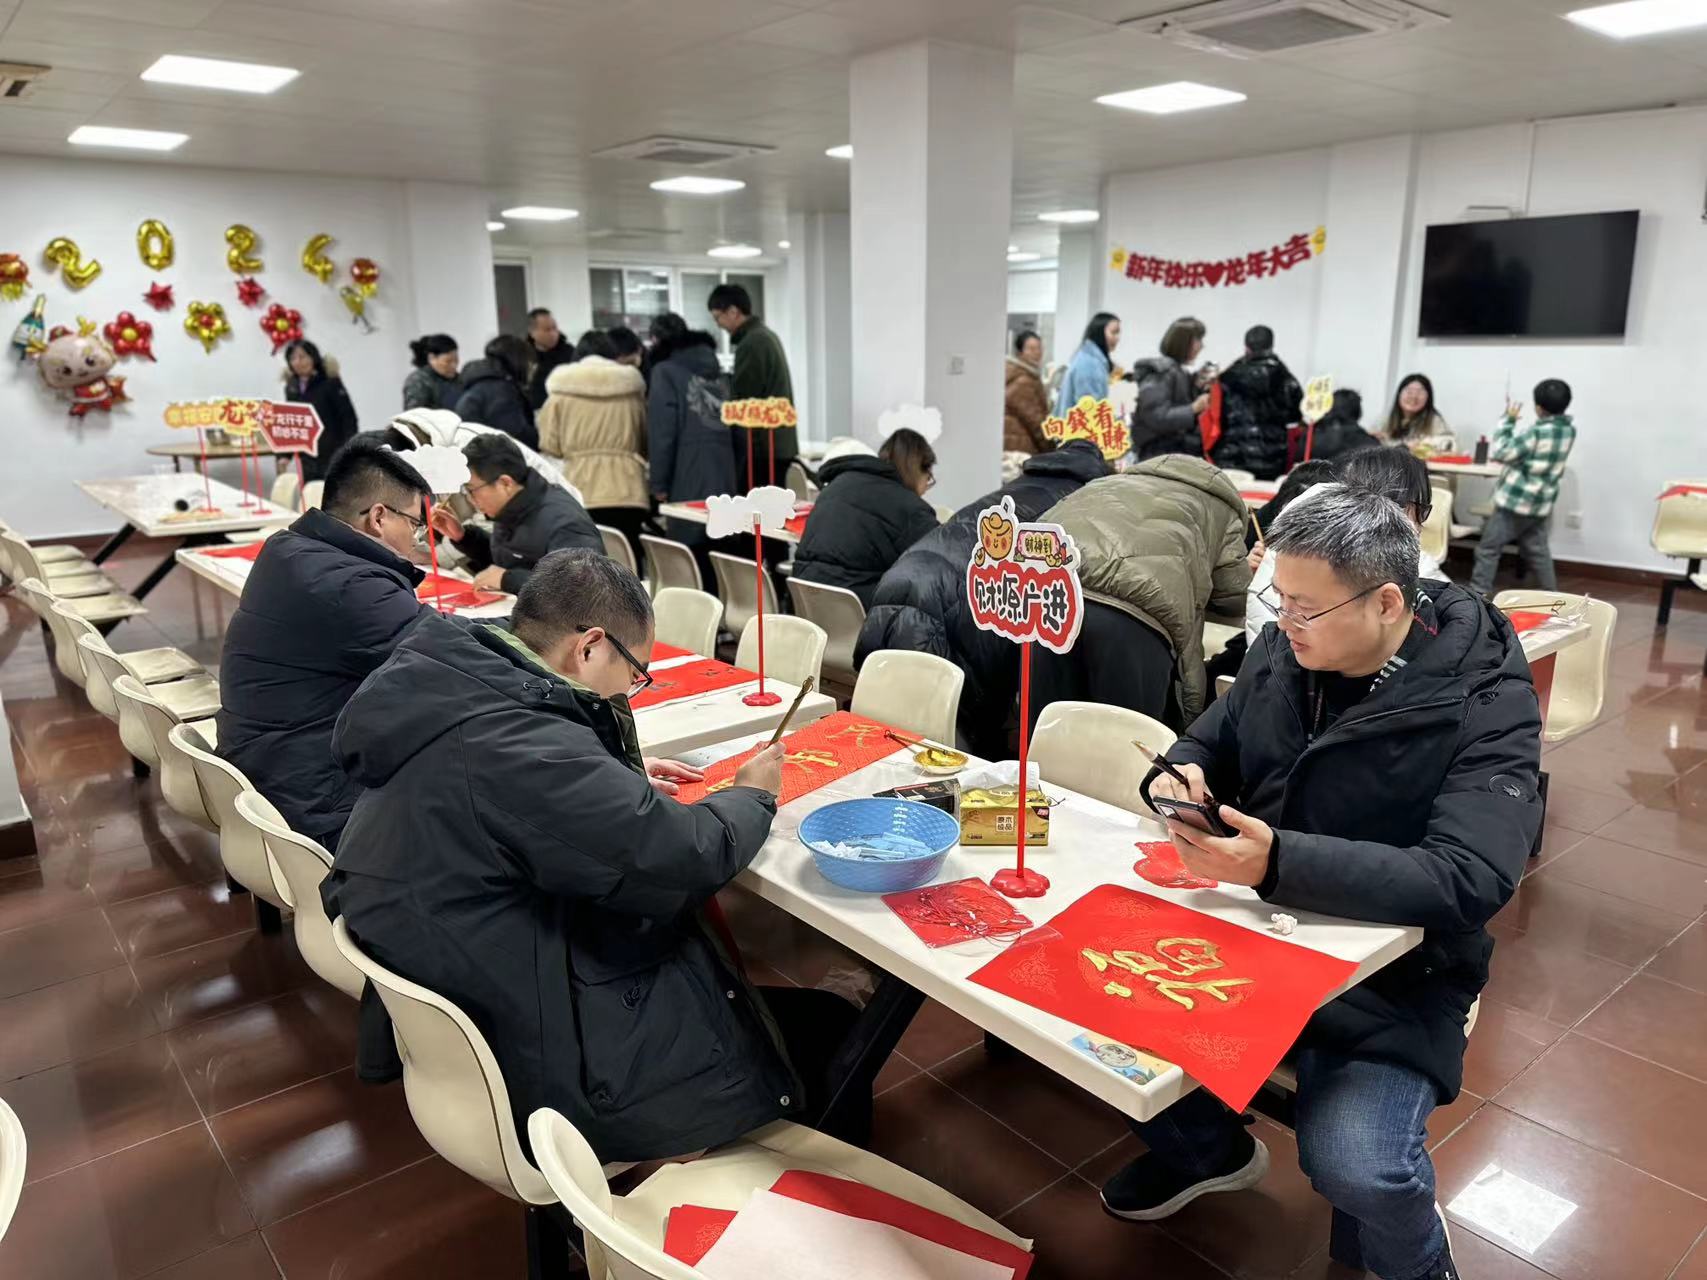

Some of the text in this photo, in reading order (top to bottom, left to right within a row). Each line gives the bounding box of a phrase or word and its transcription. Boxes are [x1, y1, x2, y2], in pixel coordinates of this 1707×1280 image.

[1125, 232, 1311, 288] 新年快乐 龙年大吉
[1024, 536, 1052, 554] 财神到
[975, 573, 1067, 631] 财源广进
